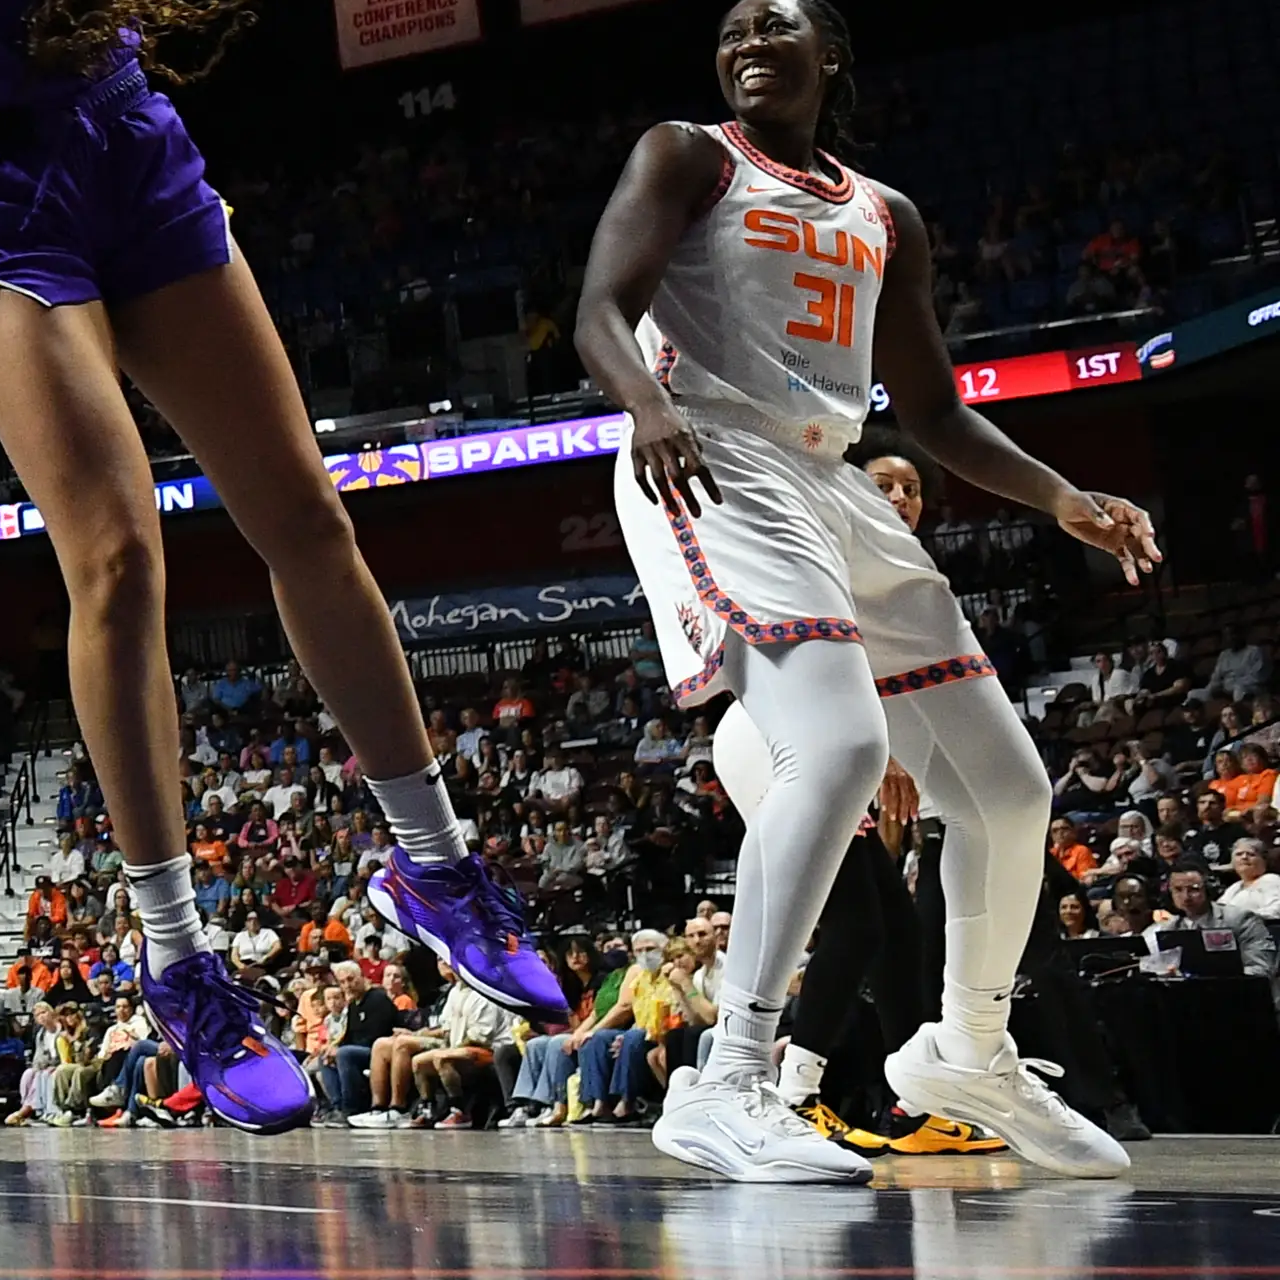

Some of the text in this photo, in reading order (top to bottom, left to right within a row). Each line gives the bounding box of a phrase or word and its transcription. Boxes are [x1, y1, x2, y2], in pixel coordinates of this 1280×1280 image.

[359, 11, 456, 47] CHAMPIONS
[397, 80, 458, 120] 114
[743, 209, 884, 281] SUN
[786, 272, 857, 348] 31
[780, 349, 811, 369] Yale
[1076, 351, 1122, 380] 1ST
[813, 372, 860, 397] Haven
[960, 367, 1000, 400] 12
[429, 420, 627, 474] SPARKS
[559, 515, 622, 553] 22
[536, 585, 617, 623] Sun
